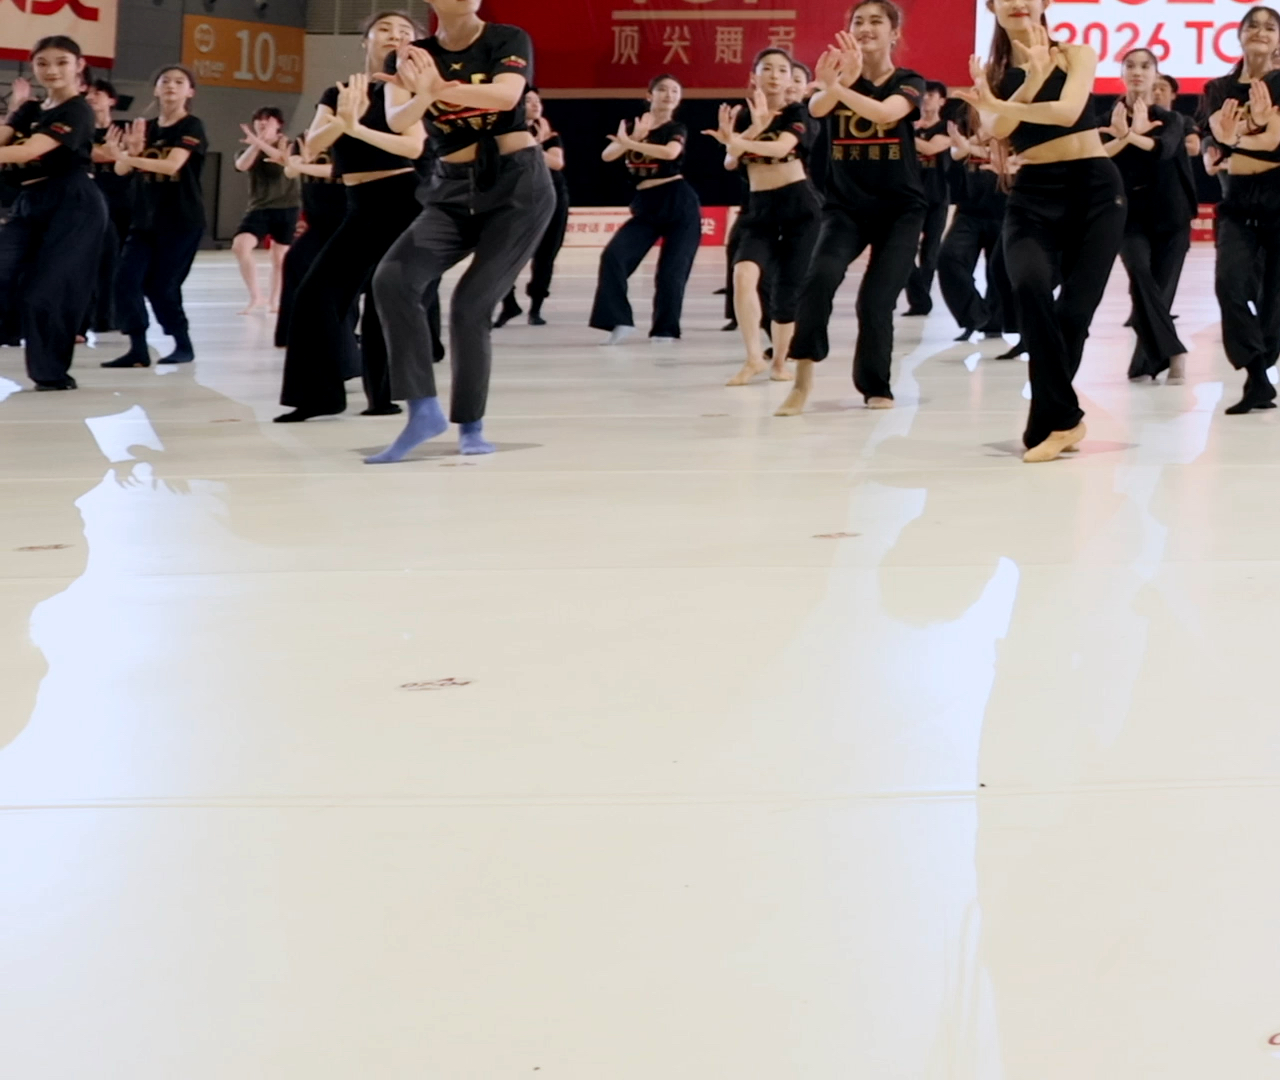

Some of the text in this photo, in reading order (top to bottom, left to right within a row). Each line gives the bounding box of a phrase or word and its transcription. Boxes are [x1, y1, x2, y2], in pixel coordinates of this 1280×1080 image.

[233, 29, 276, 82] 10
[611, 25, 796, 64] 顶尖舞者
